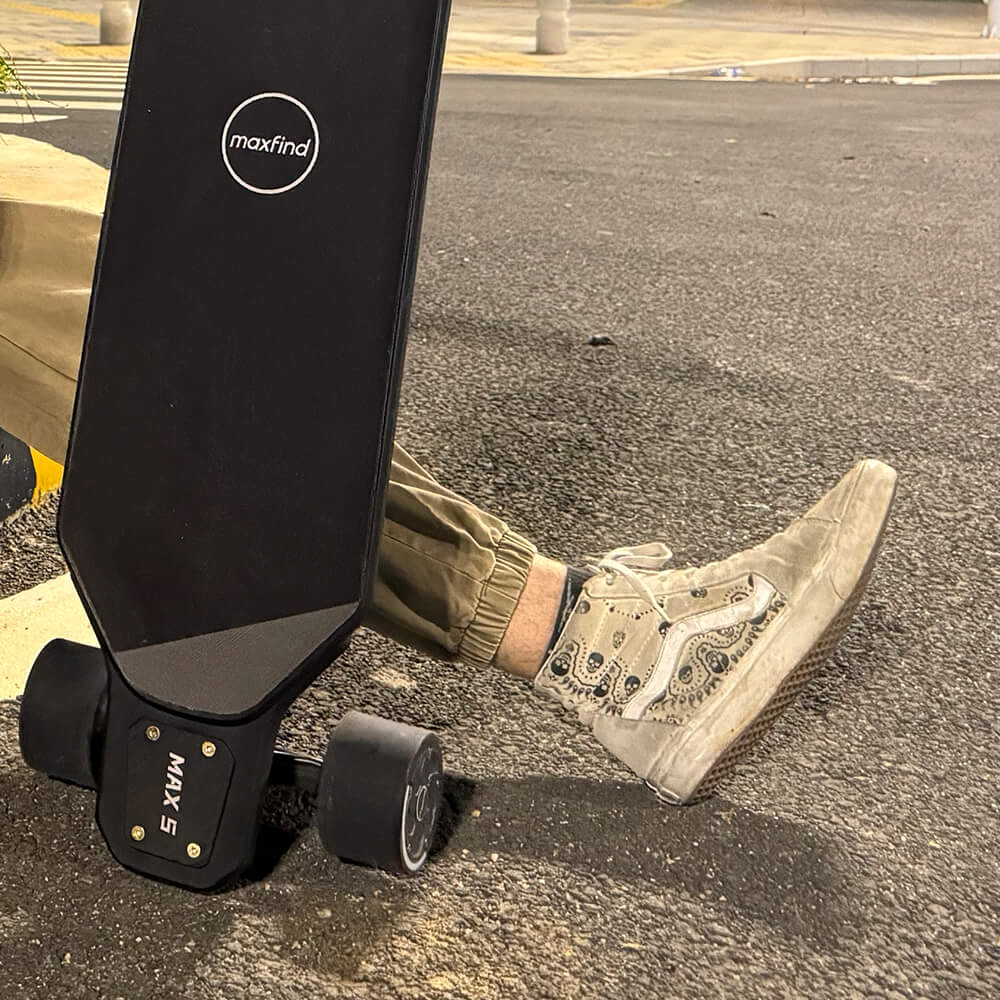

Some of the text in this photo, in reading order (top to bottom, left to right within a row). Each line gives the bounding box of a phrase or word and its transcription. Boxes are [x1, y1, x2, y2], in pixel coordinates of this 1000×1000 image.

[229, 134, 312, 157] maxfind
[159, 751, 186, 836] MAX 5
